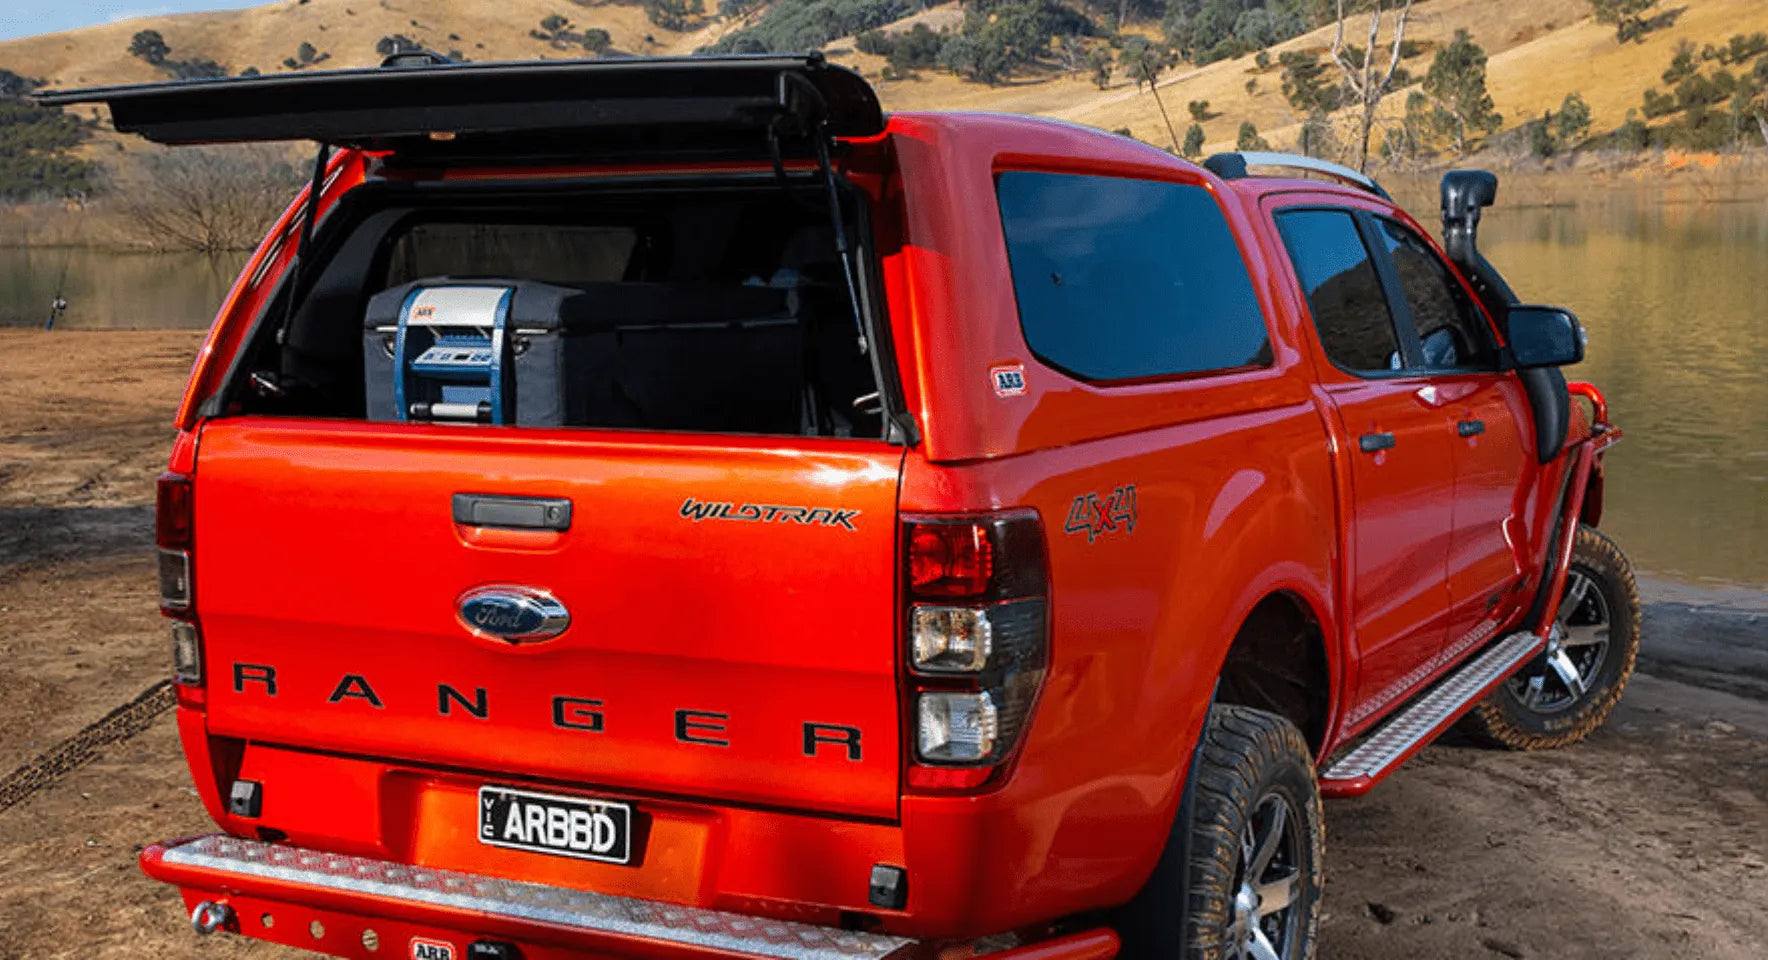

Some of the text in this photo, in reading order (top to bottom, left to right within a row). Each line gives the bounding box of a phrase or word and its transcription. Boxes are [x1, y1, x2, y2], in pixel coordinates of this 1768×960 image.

[999, 373, 1023, 390] ARB
[679, 497, 861, 532] WILDTRAK
[475, 603, 524, 628] Ford
[233, 663, 862, 761] RANGER
[483, 798, 495, 837] VIC
[504, 802, 616, 852] ARBBD
